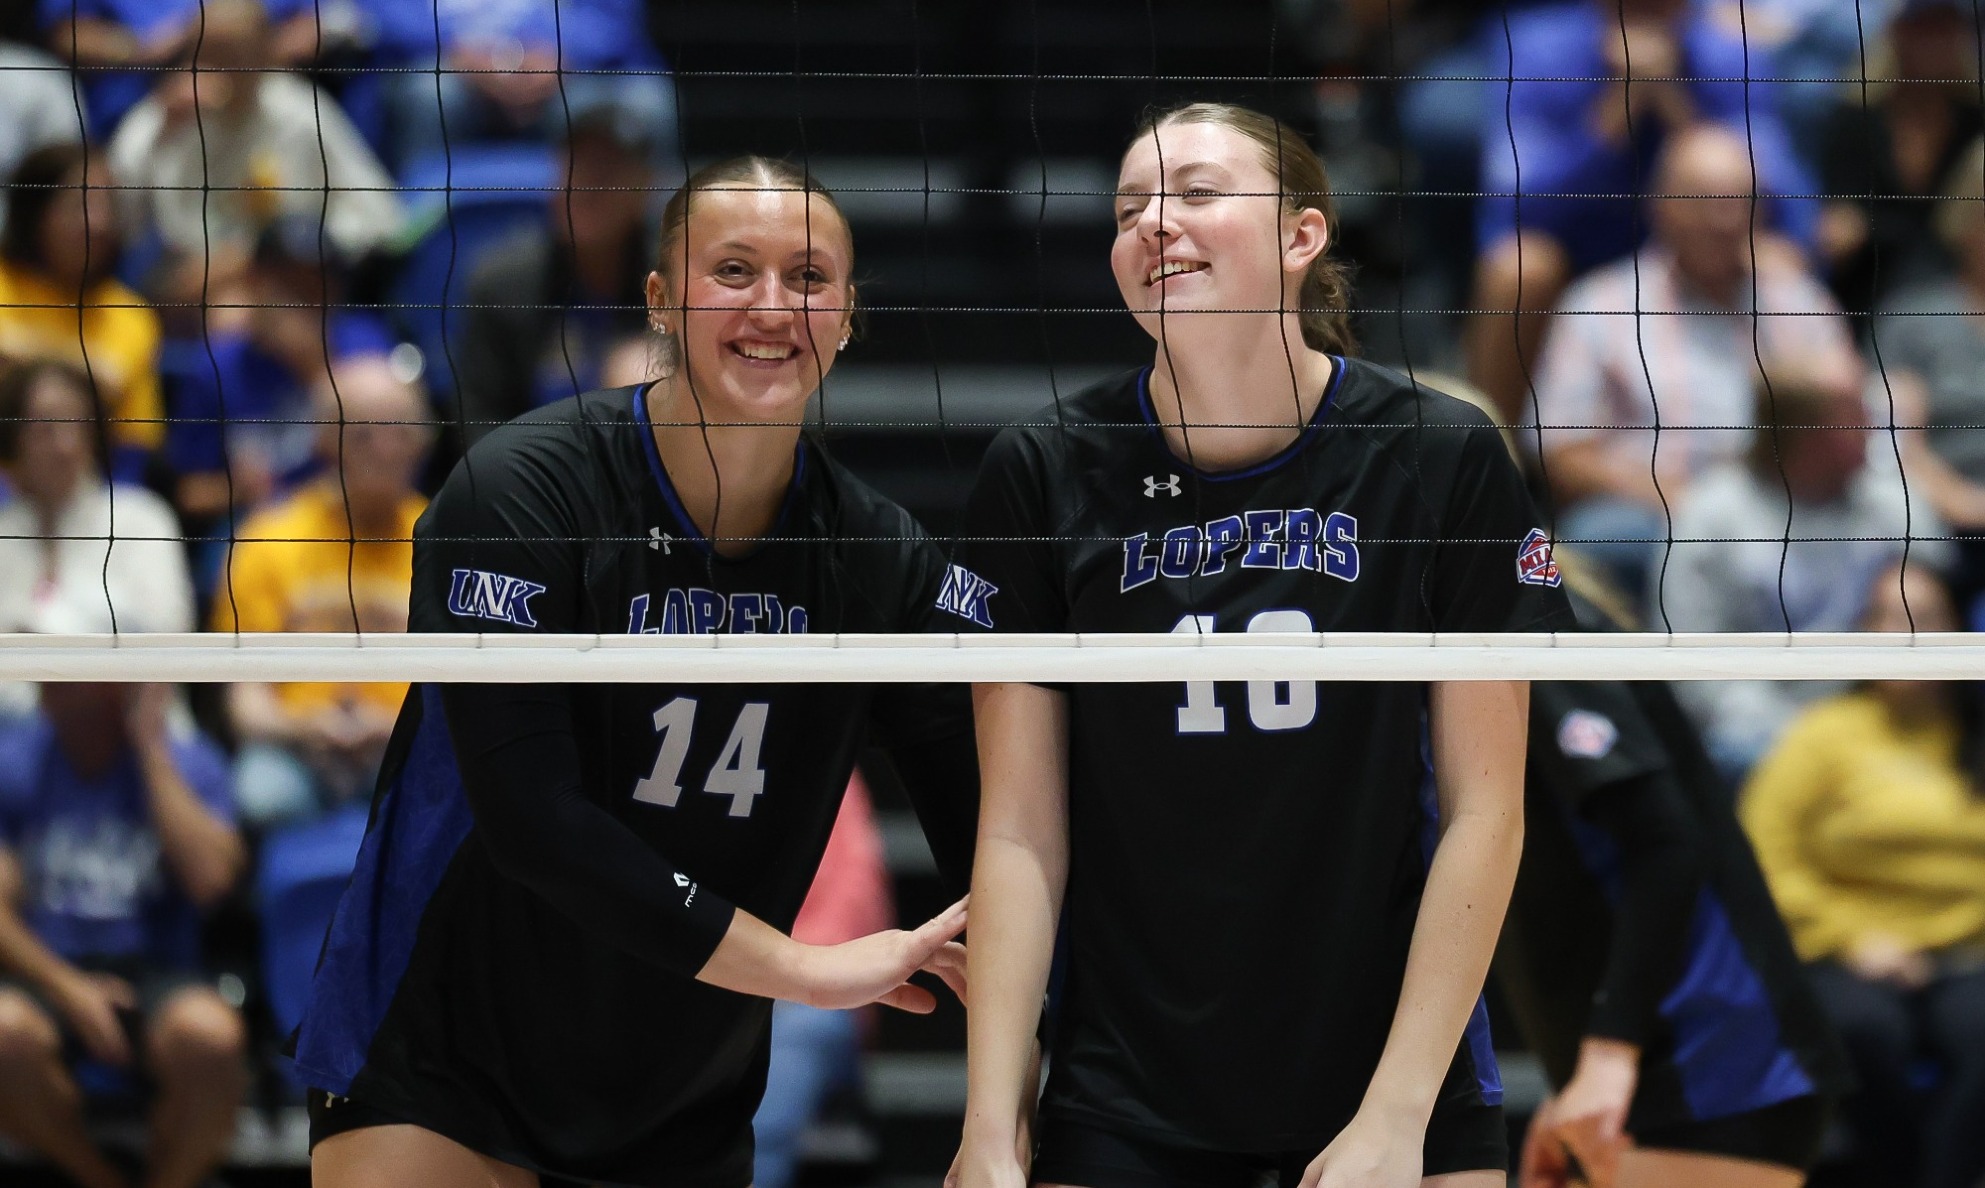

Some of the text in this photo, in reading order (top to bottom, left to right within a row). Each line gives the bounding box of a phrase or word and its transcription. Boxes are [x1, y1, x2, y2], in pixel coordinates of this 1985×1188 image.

[1120, 508, 1360, 594] LOPERS
[1518, 547, 1554, 576] MIA
[448, 568, 546, 628] UNK
[934, 563, 999, 629] NK
[631, 695, 770, 819] 14
